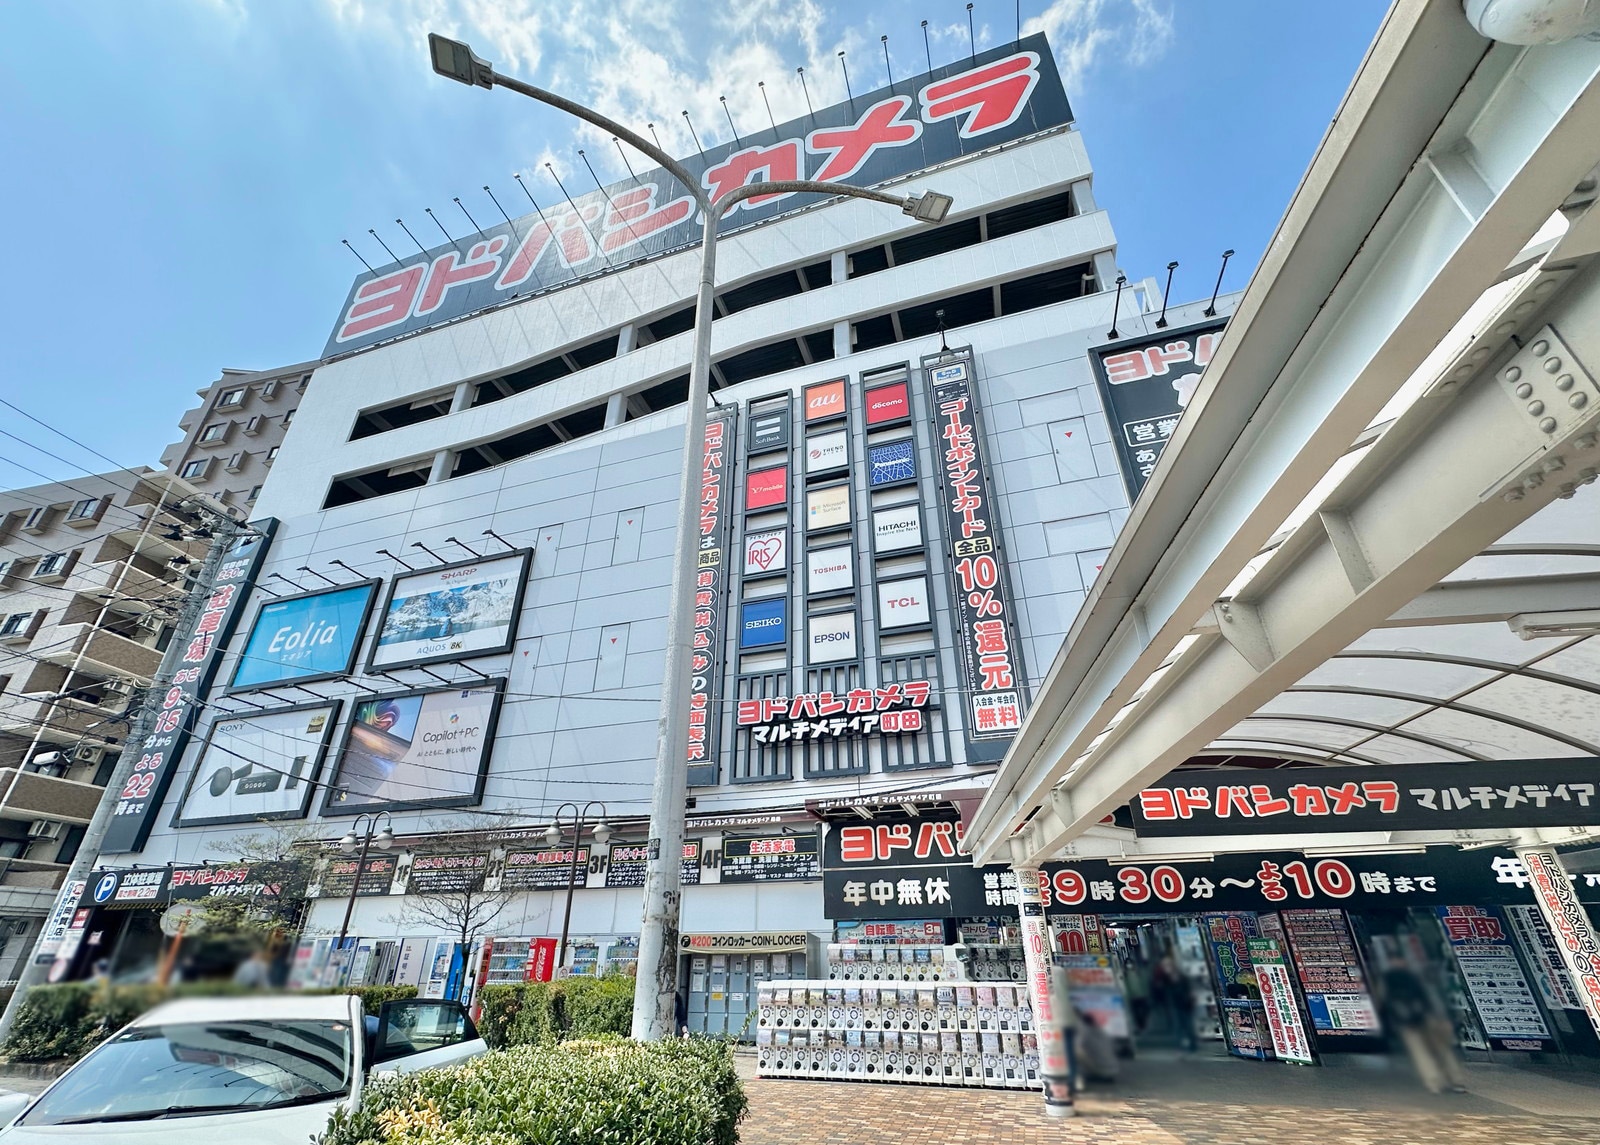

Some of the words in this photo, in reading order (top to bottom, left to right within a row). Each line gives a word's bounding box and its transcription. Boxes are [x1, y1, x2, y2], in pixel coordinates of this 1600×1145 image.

[336, 50, 1040, 343] ヨドバシカメラ
[808, 391, 841, 409] au
[871, 398, 903, 410] docomo
[755, 434, 781, 445] SoftBank
[874, 457, 910, 469] Panasonic
[939, 397, 987, 539] ゴールドポイントカード
[822, 499, 847, 509] Microsoft
[878, 520, 917, 532] HITACHI
[957, 540, 991, 556] 全品
[699, 552, 720, 565] 商品
[441, 568, 478, 580] SHARP
[813, 564, 847, 574] TOSHIBA
[887, 596, 920, 609] TCL
[745, 616, 782, 630] SEIKO
[268, 620, 339, 653] Eolia
[814, 630, 850, 644] EPSON
[417, 643, 447, 655] AQUOS
[450, 640, 463, 650] 8K
[173, 667, 201, 684] あさ
[738, 680, 931, 725] ヨドバシカメラ
[977, 704, 1018, 729] 無料
[219, 723, 246, 734] SONY
[134, 752, 162, 771] よる
[121, 774, 156, 799] 22
[818, 796, 879, 807] ヨドバシカメラ
[1139, 780, 1400, 821] ヨドバシカメラ
[1409, 783, 1596, 811] マルチメディア
[686, 818, 736, 829] ヨドバシカメラ
[749, 838, 796, 855] 生活家電
[589, 855, 608, 874] 3F
[120, 872, 164, 887] 立体駐車場
[171, 868, 249, 886] ヨドバシカメラ
[842, 876, 951, 907] 年中無休
[1442, 917, 1507, 942] 買取
[691, 935, 712, 947] ¥200
[712, 935, 752, 947] コインロッカー
[536, 946, 547, 982] Coca-Cola
